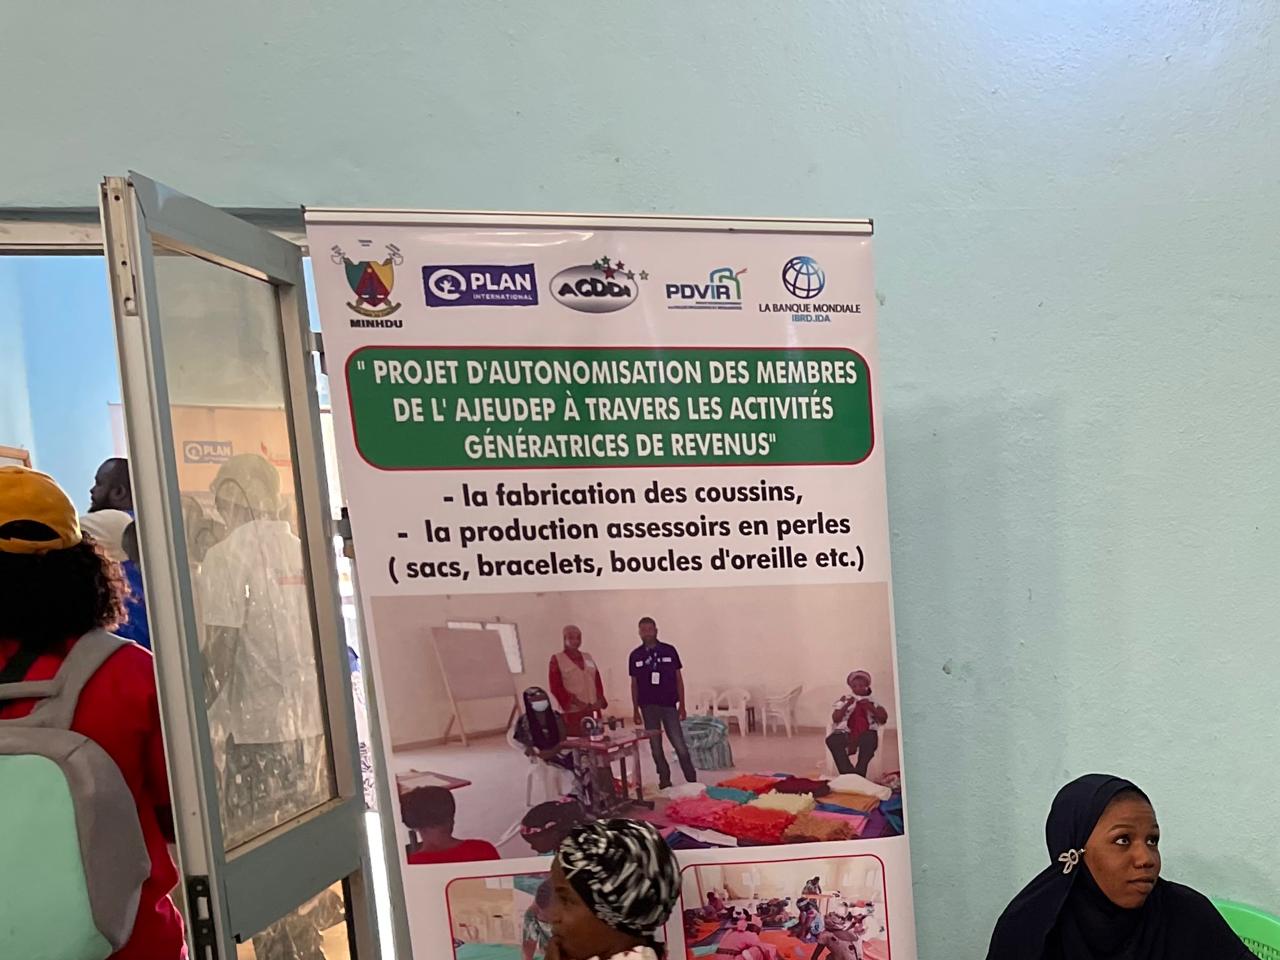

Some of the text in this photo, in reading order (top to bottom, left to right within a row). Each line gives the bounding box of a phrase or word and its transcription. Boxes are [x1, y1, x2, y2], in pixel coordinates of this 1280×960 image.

[471, 273, 532, 290] PLAN
[666, 284, 731, 299] PDVIR
[759, 304, 861, 313] LA BANQUE MONDIALE
[350, 320, 403, 328] MINHDU
[373, 360, 857, 384] PROJET D'AUTONOMISATION DES MEMBRES
[393, 389, 833, 422] DE L' AJEUDEP À TRAVERS LES ACTIVITÉS
[464, 427, 776, 459] GÉNÉRATRICES DE REVENUS"
[462, 479, 802, 507] la fabrication des coussins,
[425, 512, 850, 548] la production assessoirs en perles
[406, 545, 864, 581] sacs, bracelets, boucles d'oreille etc.)
